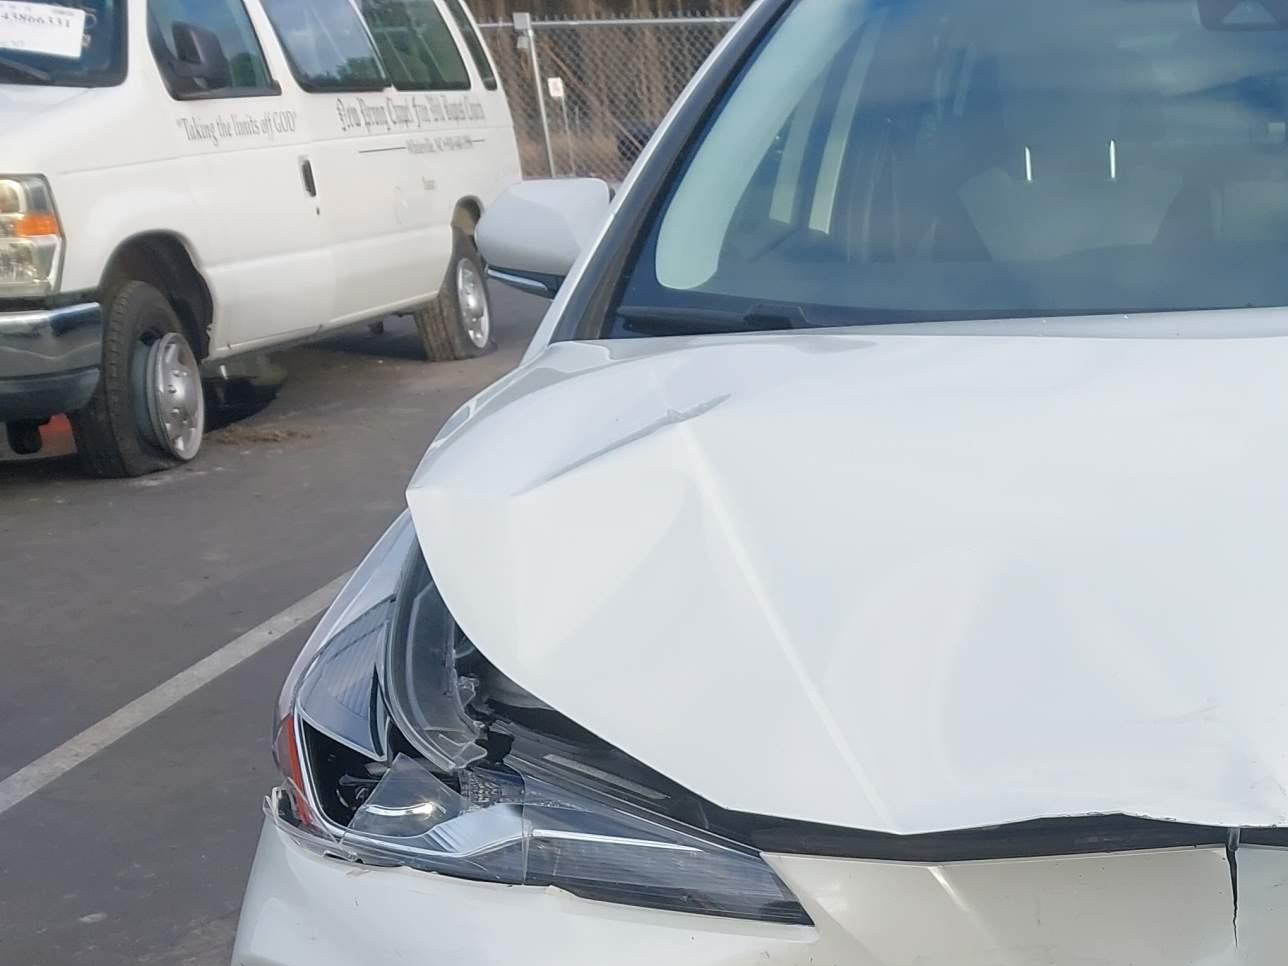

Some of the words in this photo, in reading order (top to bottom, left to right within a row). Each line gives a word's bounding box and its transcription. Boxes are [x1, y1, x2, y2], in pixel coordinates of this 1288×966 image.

[216, 115, 231, 137] the
[231, 113, 260, 136] limits
[260, 111, 275, 142] off
